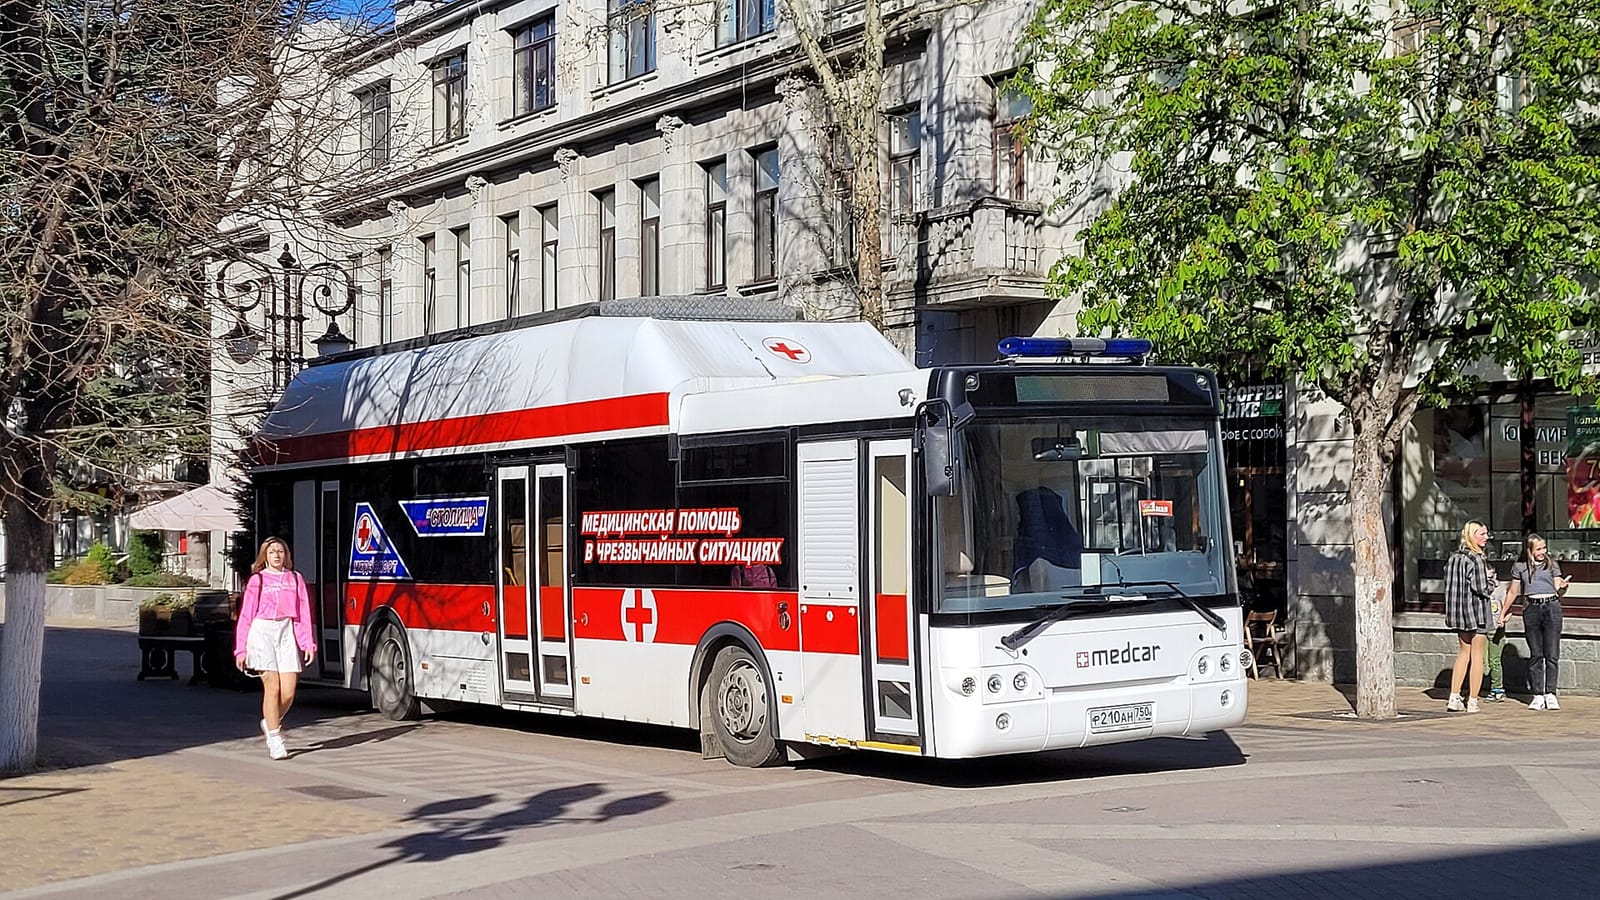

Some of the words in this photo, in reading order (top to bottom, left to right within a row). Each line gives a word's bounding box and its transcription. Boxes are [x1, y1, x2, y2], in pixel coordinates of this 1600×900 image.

[1227, 384, 1283, 402] COFFEE
[1227, 402, 1260, 419] LIKE
[1220, 430, 1240, 440] ОФЕ
[1242, 429, 1249, 440] С
[1250, 426, 1283, 439] СОБОЙ
[1539, 450, 1567, 465] ВЕК
[581, 511, 674, 536] МЕДИЦИНСКАЯ
[678, 510, 740, 535] ПОМОЩЬ
[585, 543, 593, 561] В
[597, 535, 696, 562] ЧРЕЗВЫЧАЙНЫХ
[700, 541, 781, 566] СИТУАЦИЯХ
[1092, 641, 1161, 666] medcar
[1134, 706, 1150, 718] 750
